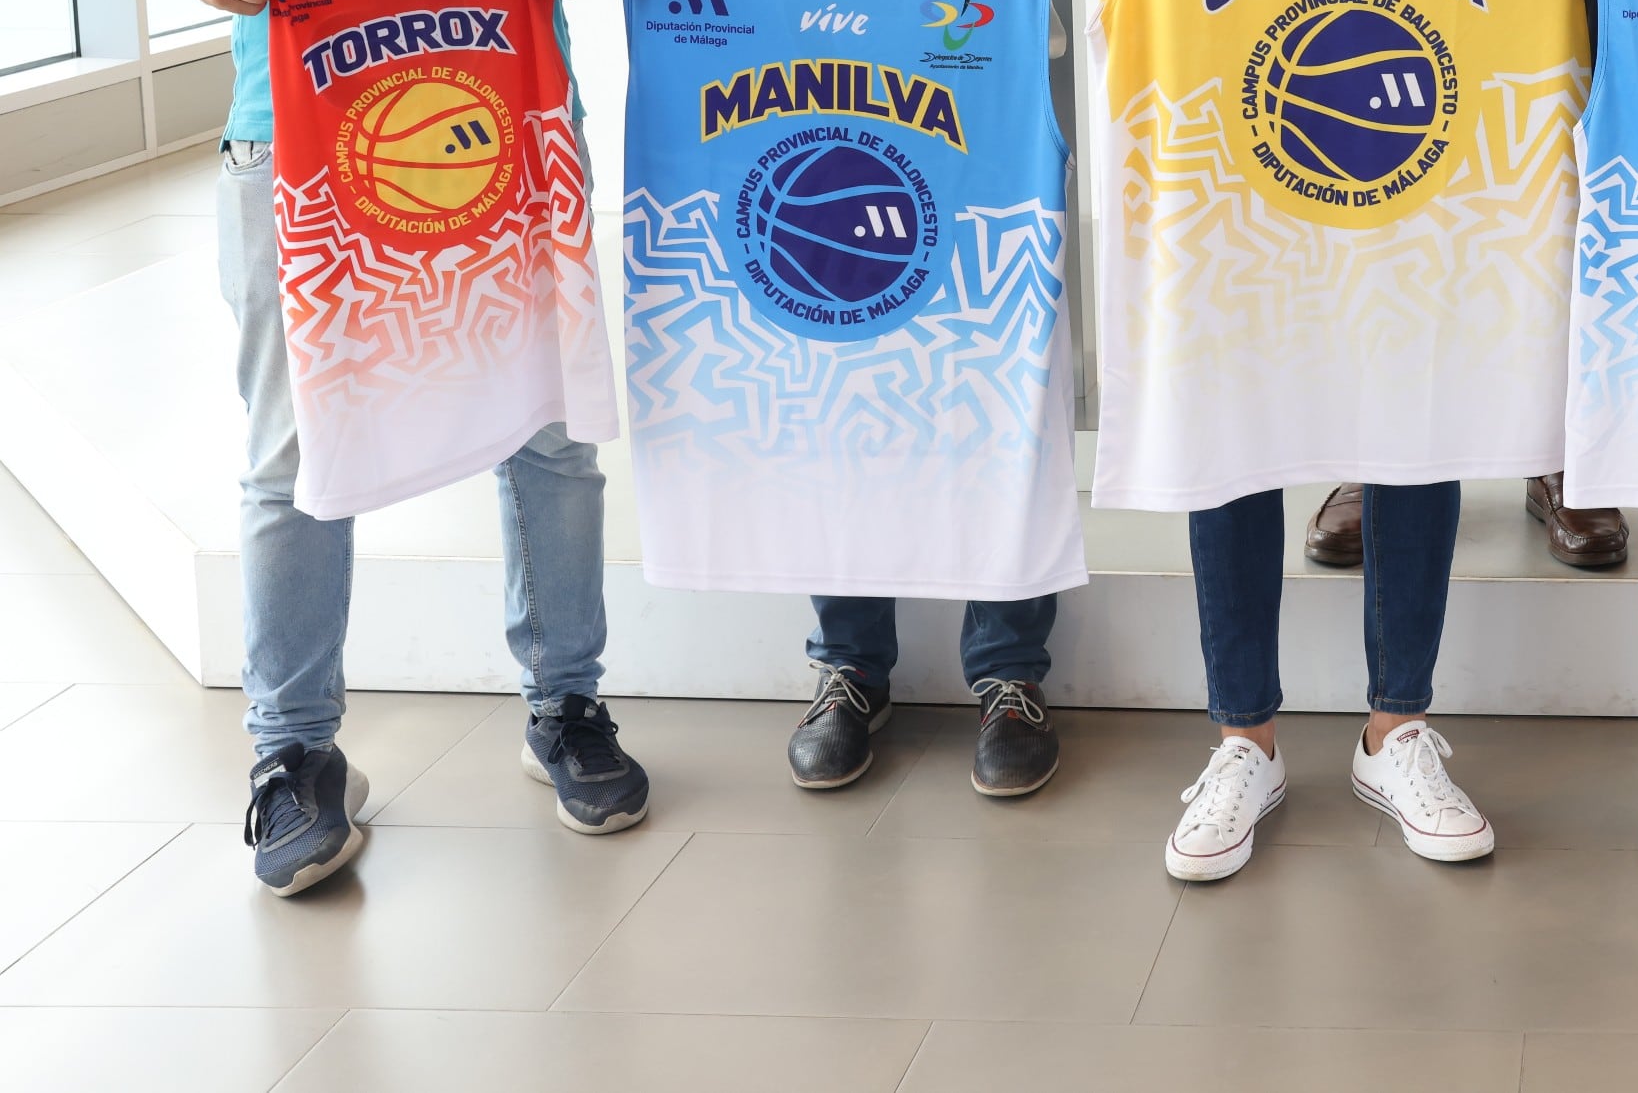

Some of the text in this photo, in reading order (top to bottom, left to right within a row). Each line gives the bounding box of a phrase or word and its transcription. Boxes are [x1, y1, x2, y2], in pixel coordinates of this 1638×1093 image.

[301, 7, 518, 97] TORROX
[646, 20, 755, 35] Diputación Provincial
[674, 33, 728, 46] de Málaga
[1241, 41, 1273, 121] CAMPUS
[1399, 5, 1459, 116] BALONCESTO
[334, 65, 515, 184] CAMPUS PROVINCIAL DE BALONCESTO
[699, 58, 969, 156] MANILVA
[354, 162, 515, 234] DIPUTACIÓN DE MÁLAGA
[735, 126, 939, 248] CAMPUS PROVINCIAL DE BALONCESTO
[1251, 138, 1450, 208] DIPUTACIÓN DE MÁLAGA
[743, 258, 931, 326] DIPUTACIÓN DE MÁLAGA
